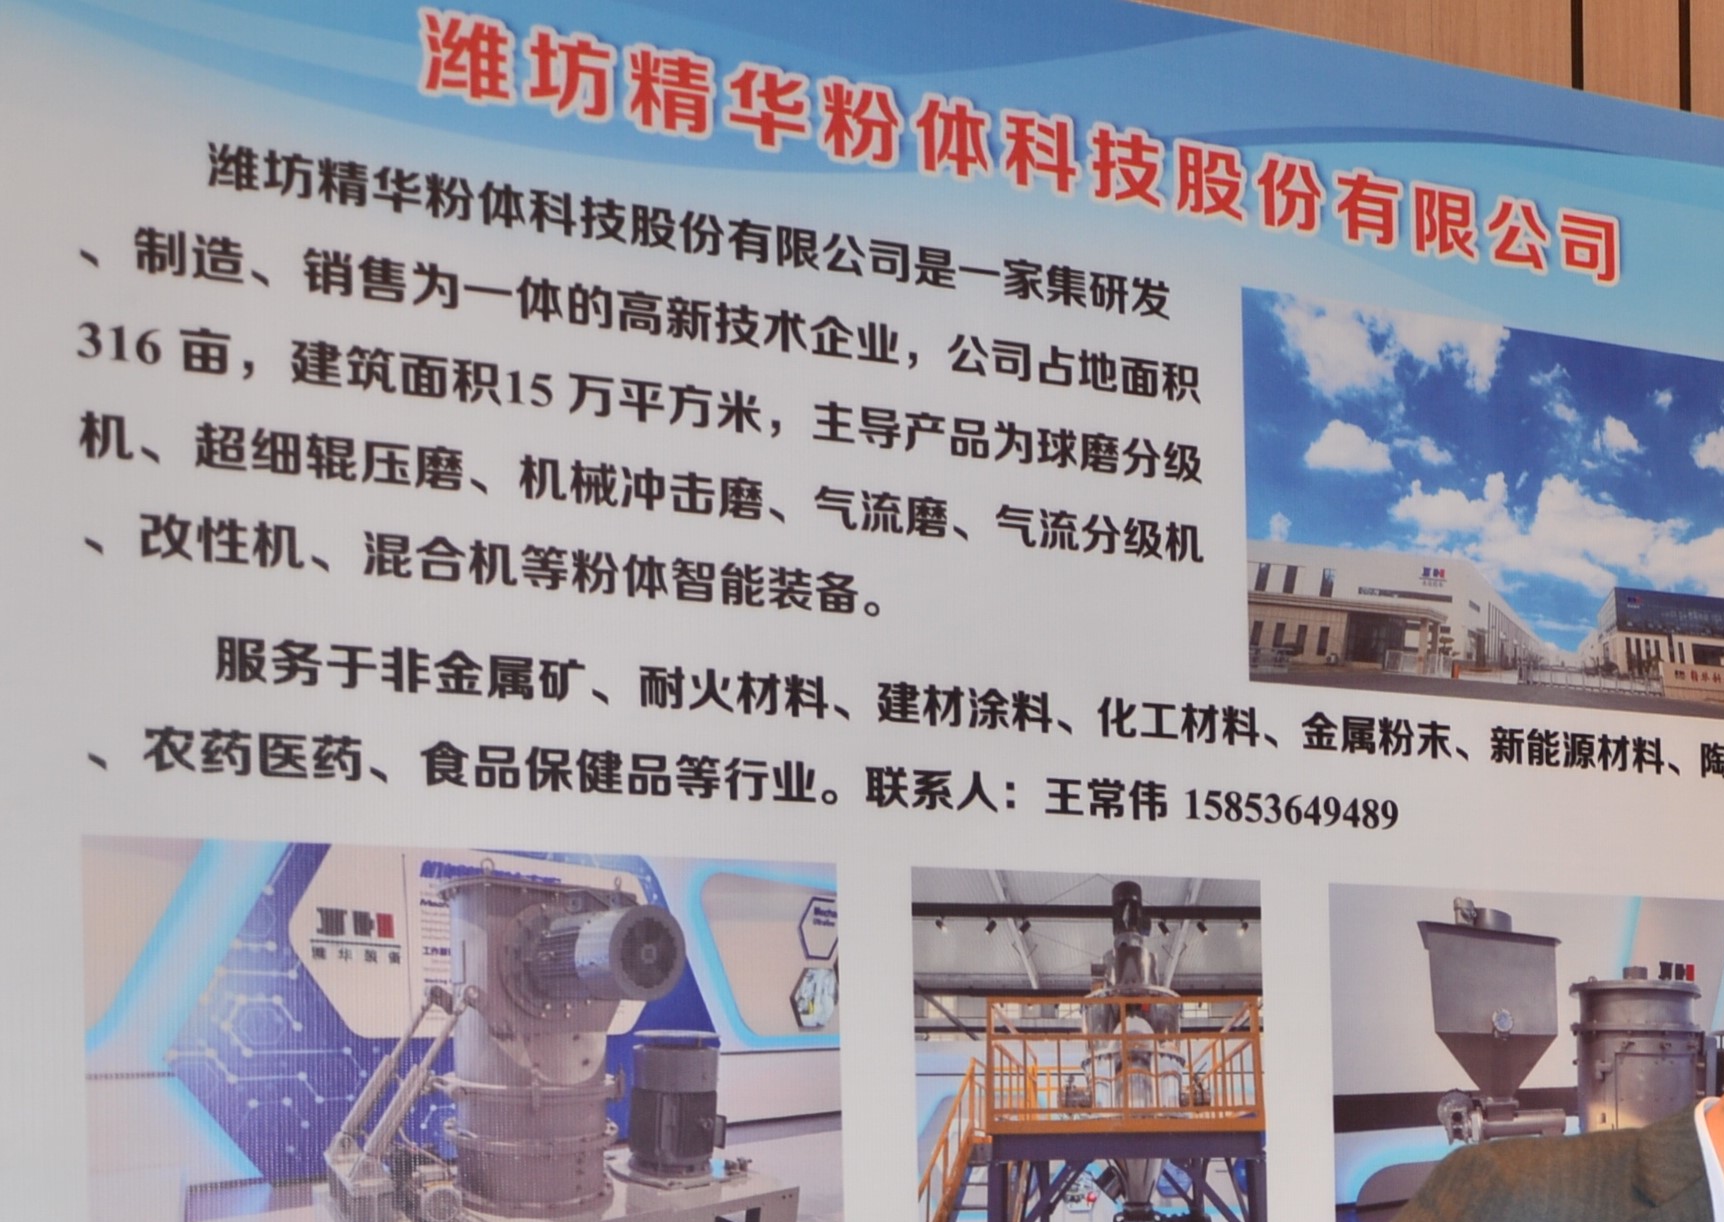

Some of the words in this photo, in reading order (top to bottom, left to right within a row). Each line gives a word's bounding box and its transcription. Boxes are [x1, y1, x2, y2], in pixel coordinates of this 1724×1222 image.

[423, 14, 1622, 282] 潍坊精华粉体科技股份有限公司
[208, 143, 1170, 321] 潍坊精华粉体科技股份有限公司是一家集研发
[77, 323, 161, 364] 316
[1186, 789, 1399, 832] 15853649489
